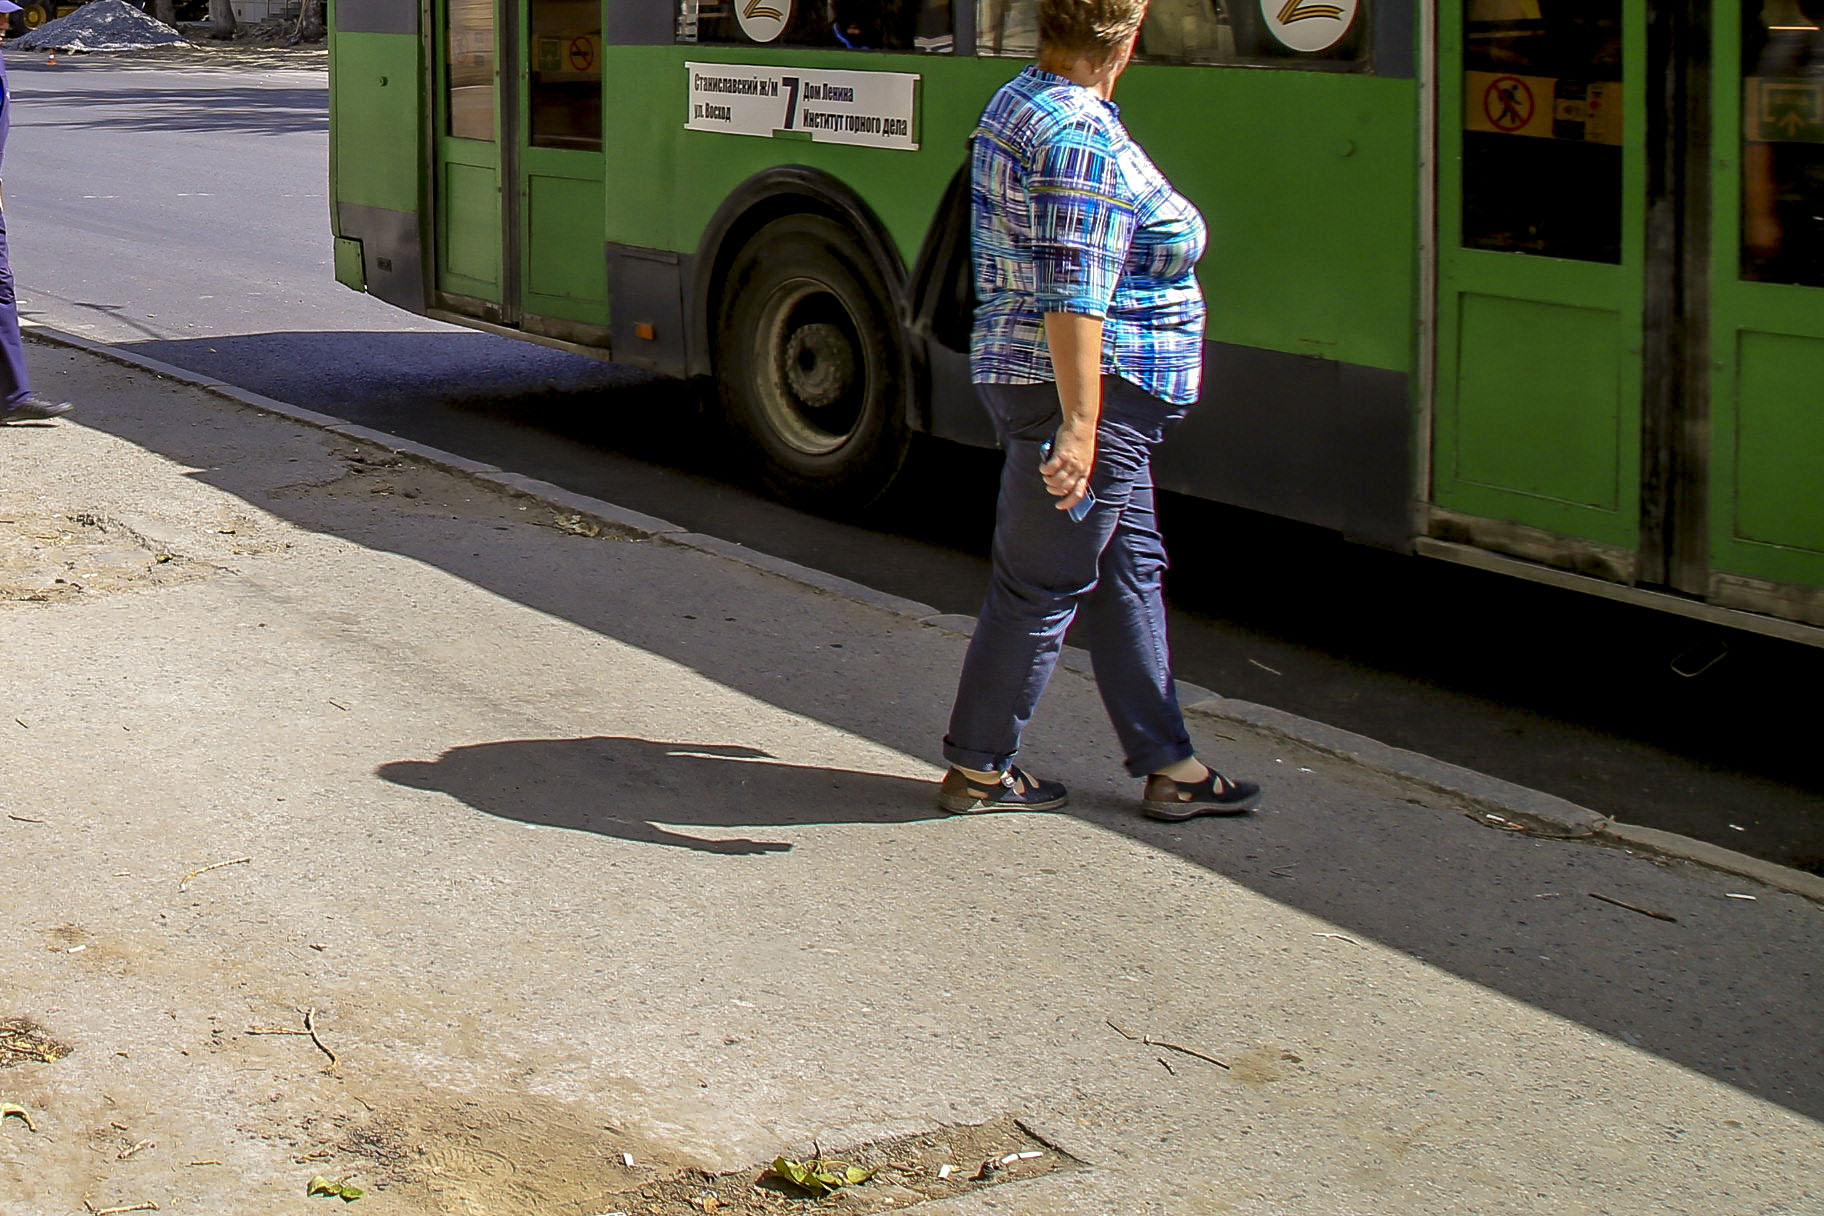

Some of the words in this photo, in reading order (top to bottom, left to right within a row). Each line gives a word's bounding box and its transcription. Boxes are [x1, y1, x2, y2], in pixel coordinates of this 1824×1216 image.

[694, 73, 758, 95] Станиславский
[759, 79, 778, 97] ж/м
[803, 82, 821, 101] Дом
[822, 83, 853, 102] Ленина
[694, 104, 704, 119] ул.
[705, 103, 731, 122] Восход
[782, 77, 801, 129] 7
[803, 109, 844, 131] Институт
[844, 113, 881, 133] горного
[882, 118, 908, 137] дела
